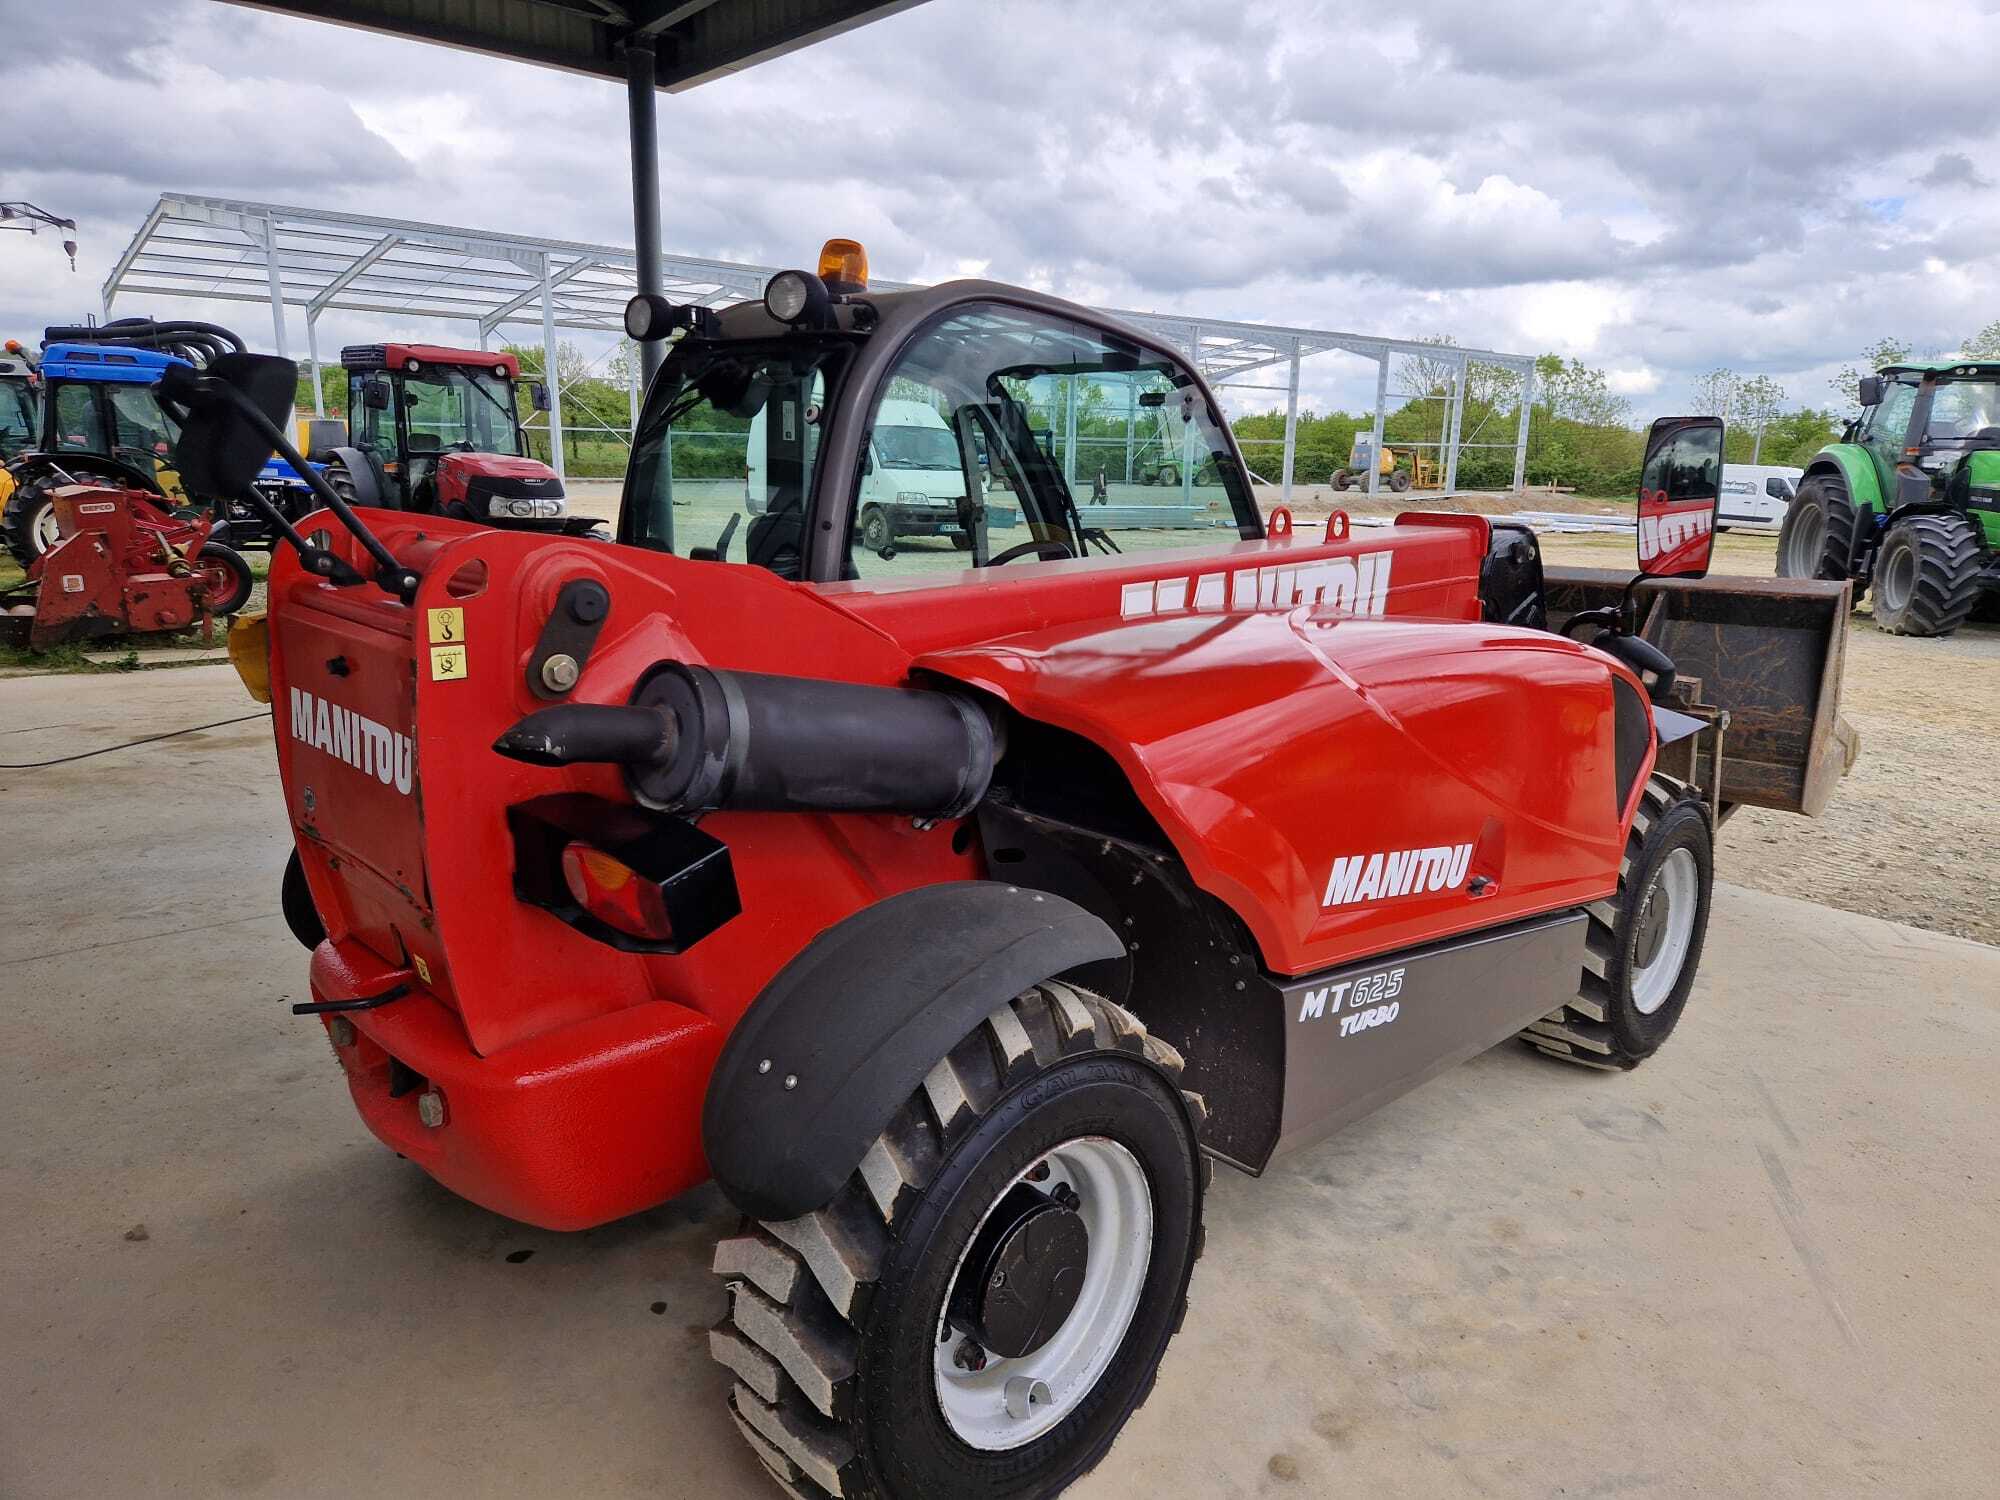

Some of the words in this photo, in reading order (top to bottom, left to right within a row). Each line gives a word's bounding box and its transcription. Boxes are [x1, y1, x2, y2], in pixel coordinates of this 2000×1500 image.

[290, 685, 412, 795] MANITOU
[1321, 843, 1473, 907] MANITOU
[1340, 1001, 1400, 1038] TURBO
